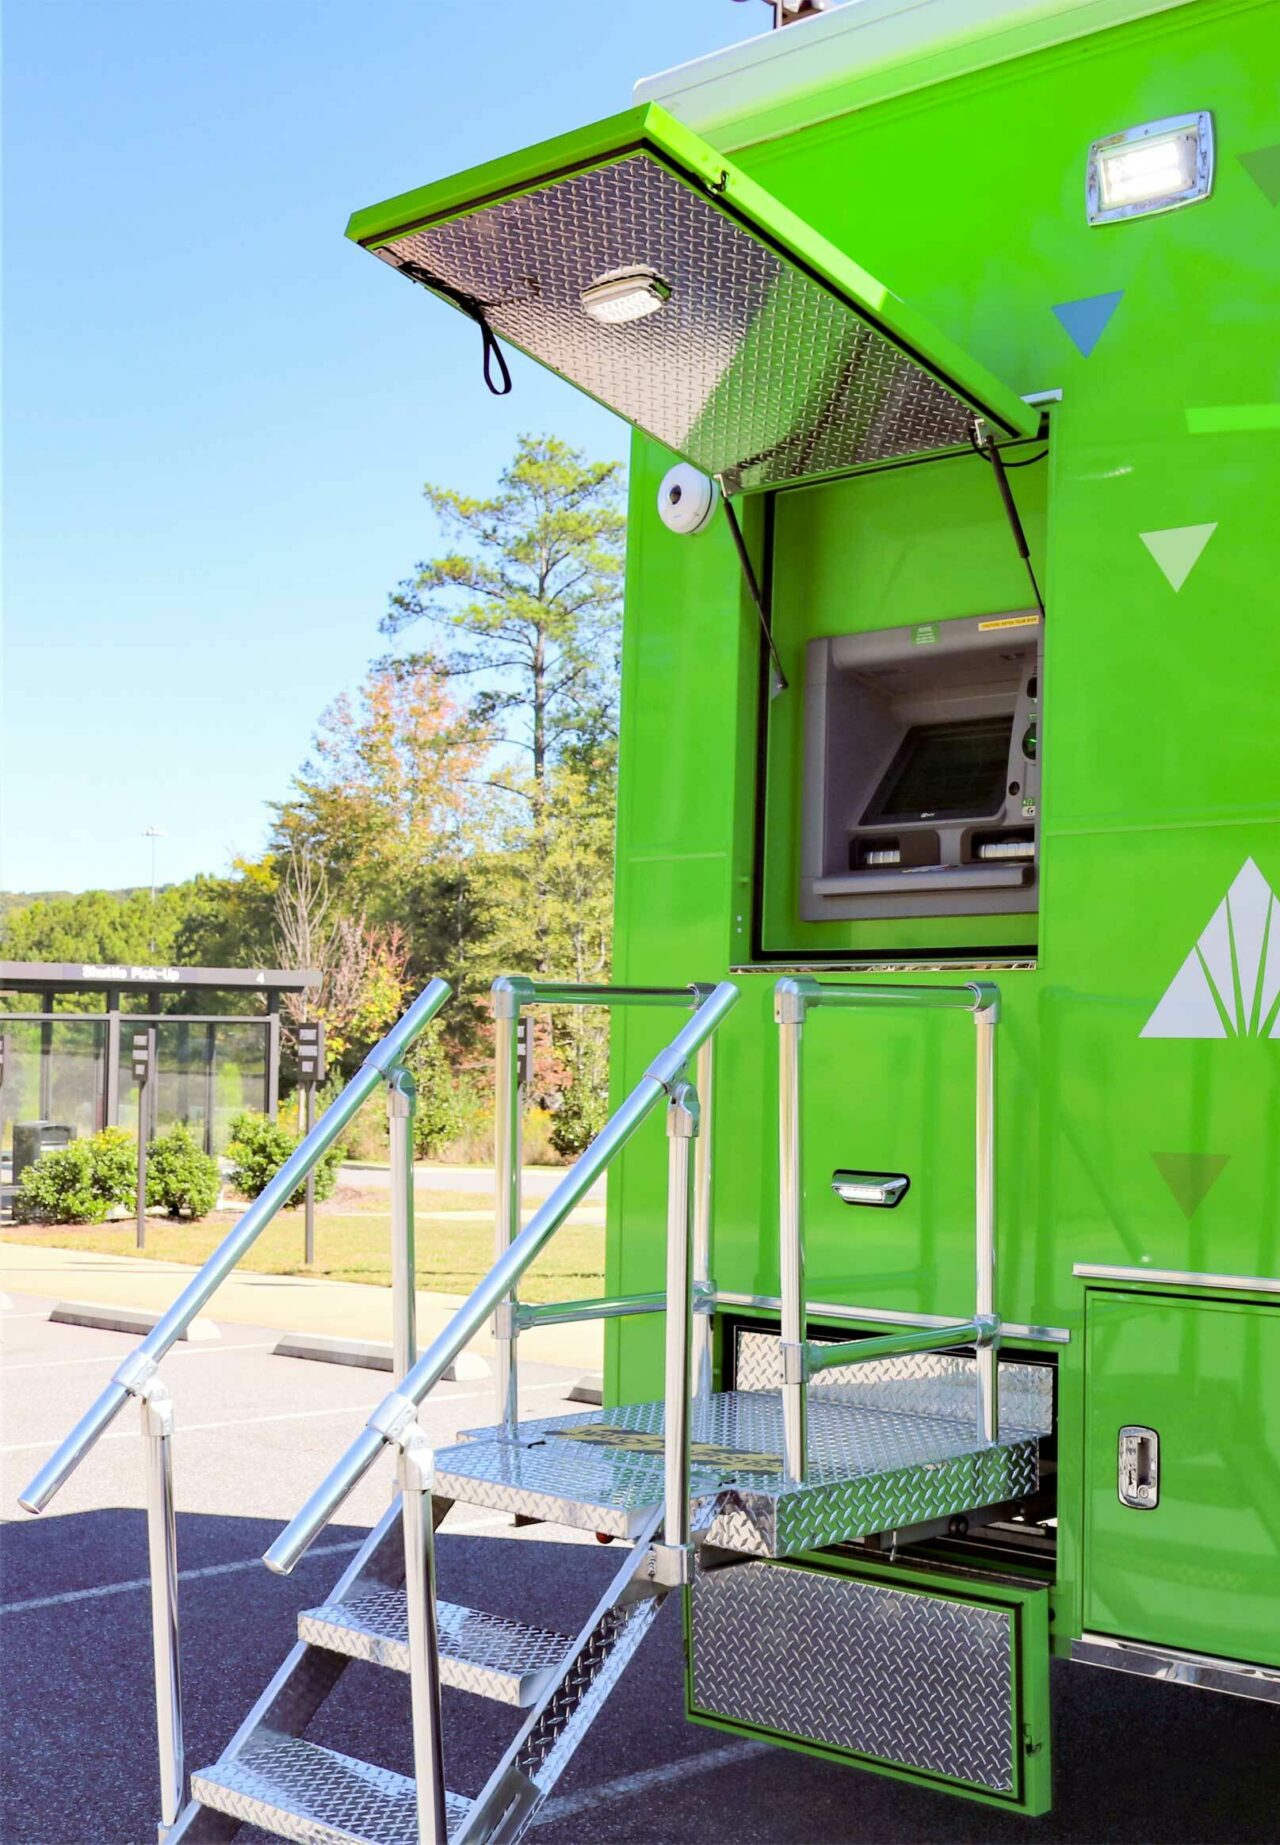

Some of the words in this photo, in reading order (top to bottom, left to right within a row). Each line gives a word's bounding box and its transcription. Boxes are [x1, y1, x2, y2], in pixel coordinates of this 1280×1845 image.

[82, 965, 127, 979] Shuttle
[131, 967, 180, 982] Pick-Up
[256, 972, 265, 984] 4
